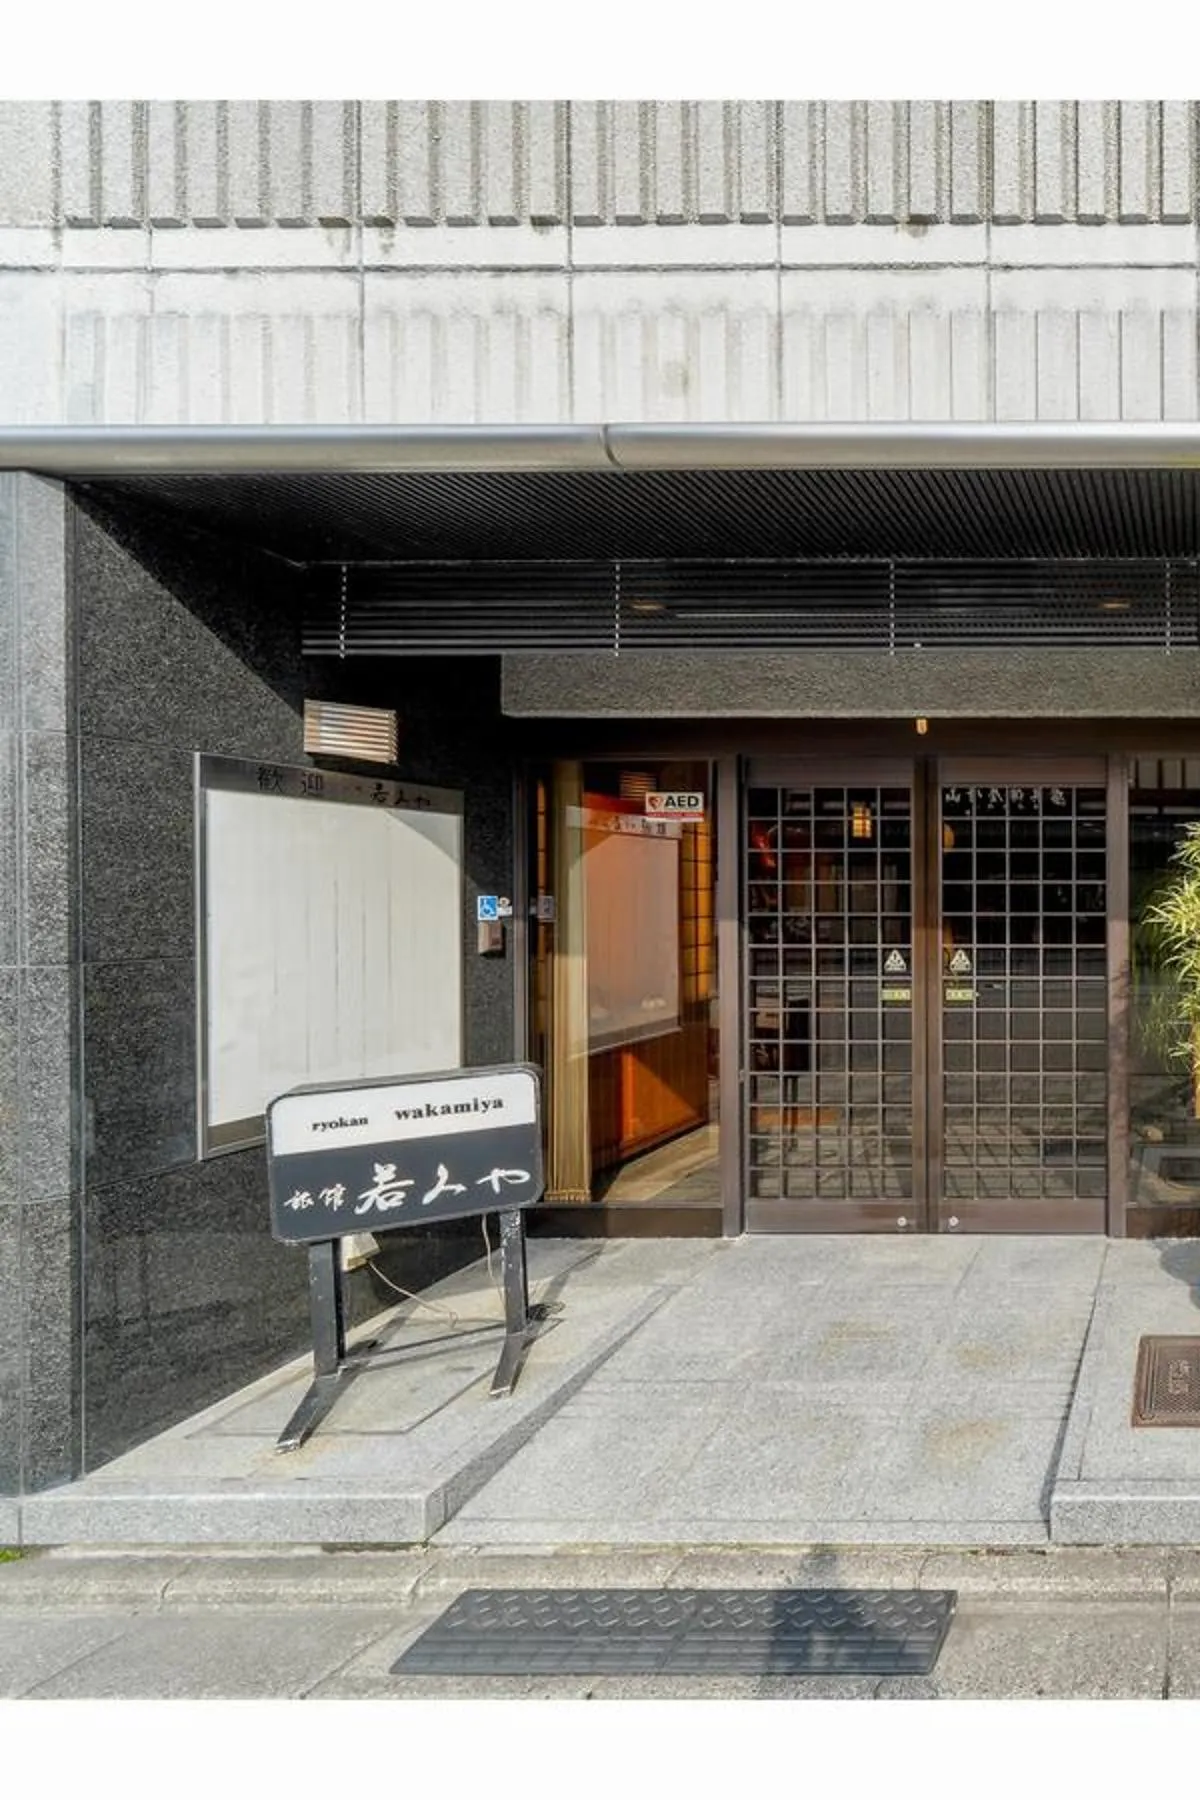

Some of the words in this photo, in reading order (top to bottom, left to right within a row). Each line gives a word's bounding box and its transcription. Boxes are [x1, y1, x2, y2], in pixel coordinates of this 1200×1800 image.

[664, 795, 699, 809] AED
[311, 1115, 369, 1133] ryokan
[394, 1096, 504, 1122] wakamiya
